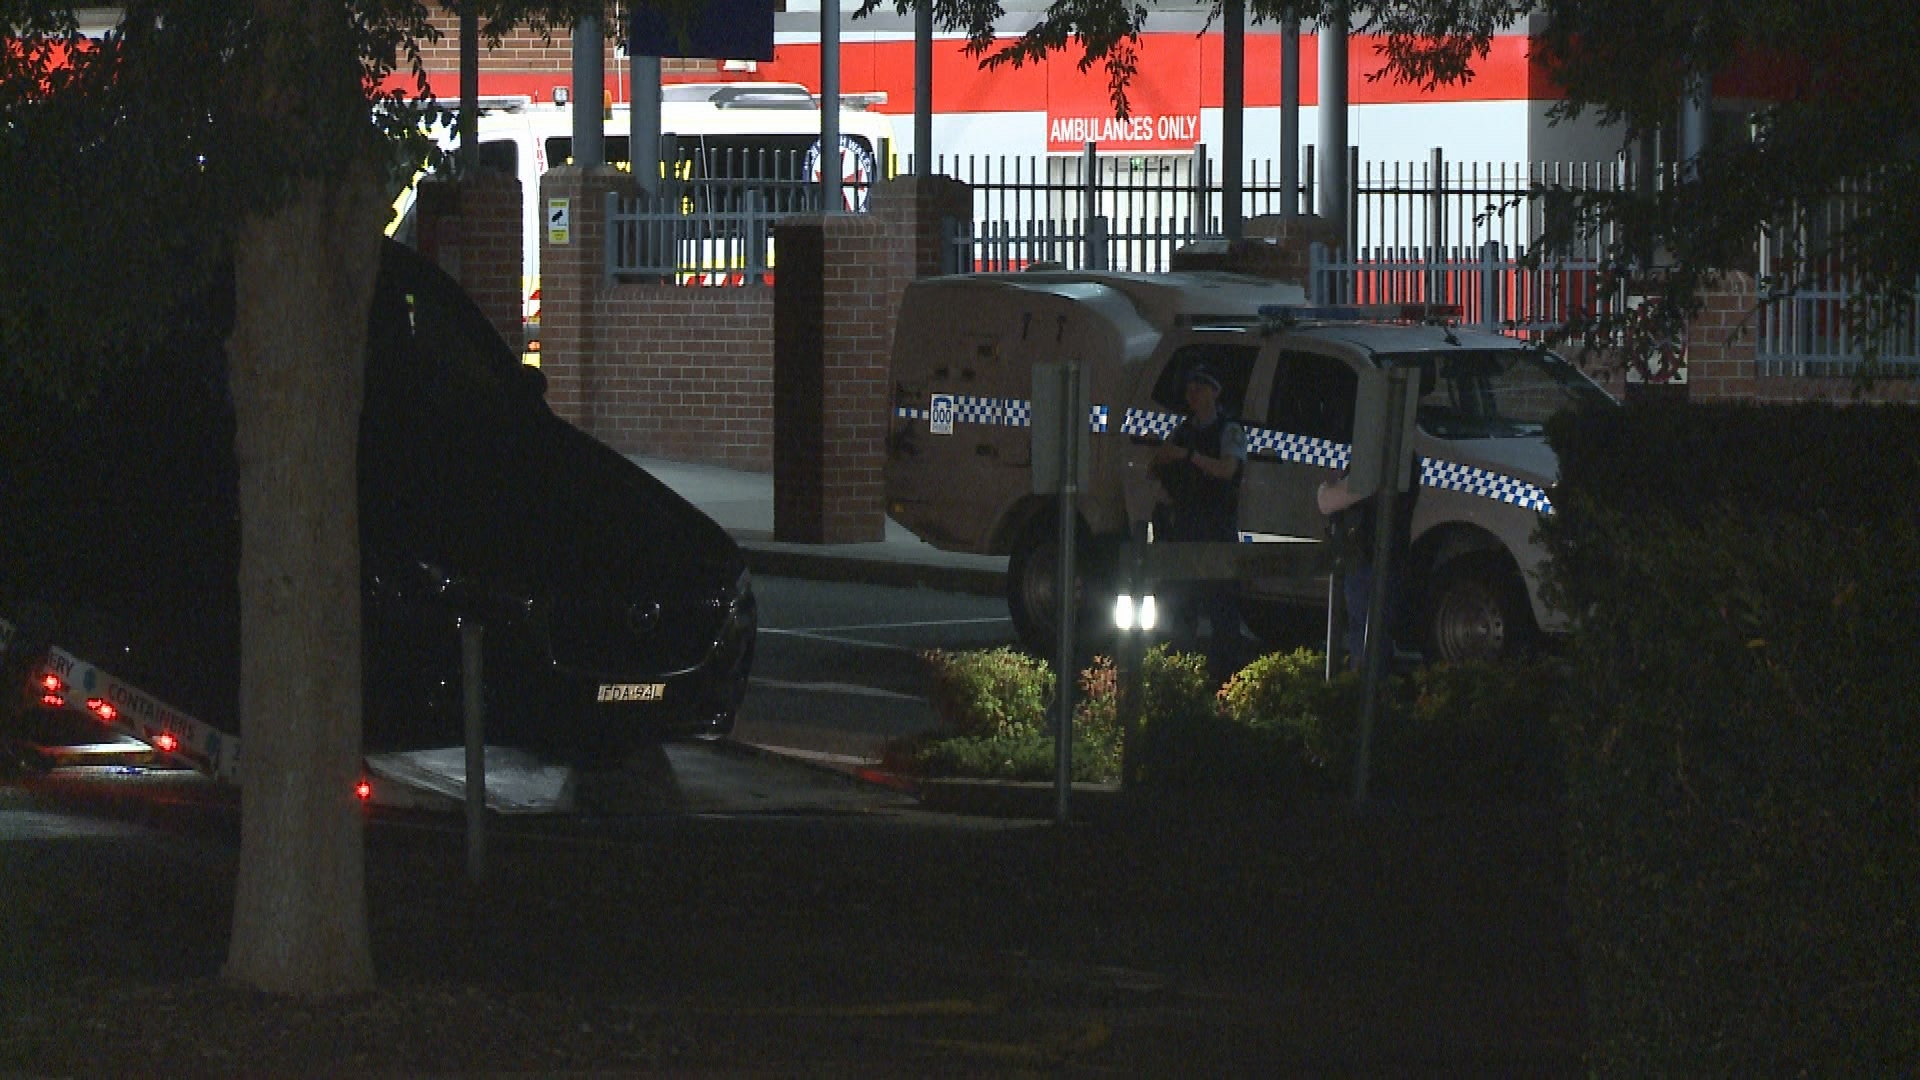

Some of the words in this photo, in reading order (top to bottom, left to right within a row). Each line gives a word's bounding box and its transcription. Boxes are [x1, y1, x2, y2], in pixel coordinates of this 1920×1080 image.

[1050, 116, 1153, 142] AMBULANCES
[1158, 115, 1197, 140] ONLY
[933, 408, 951, 424] 000
